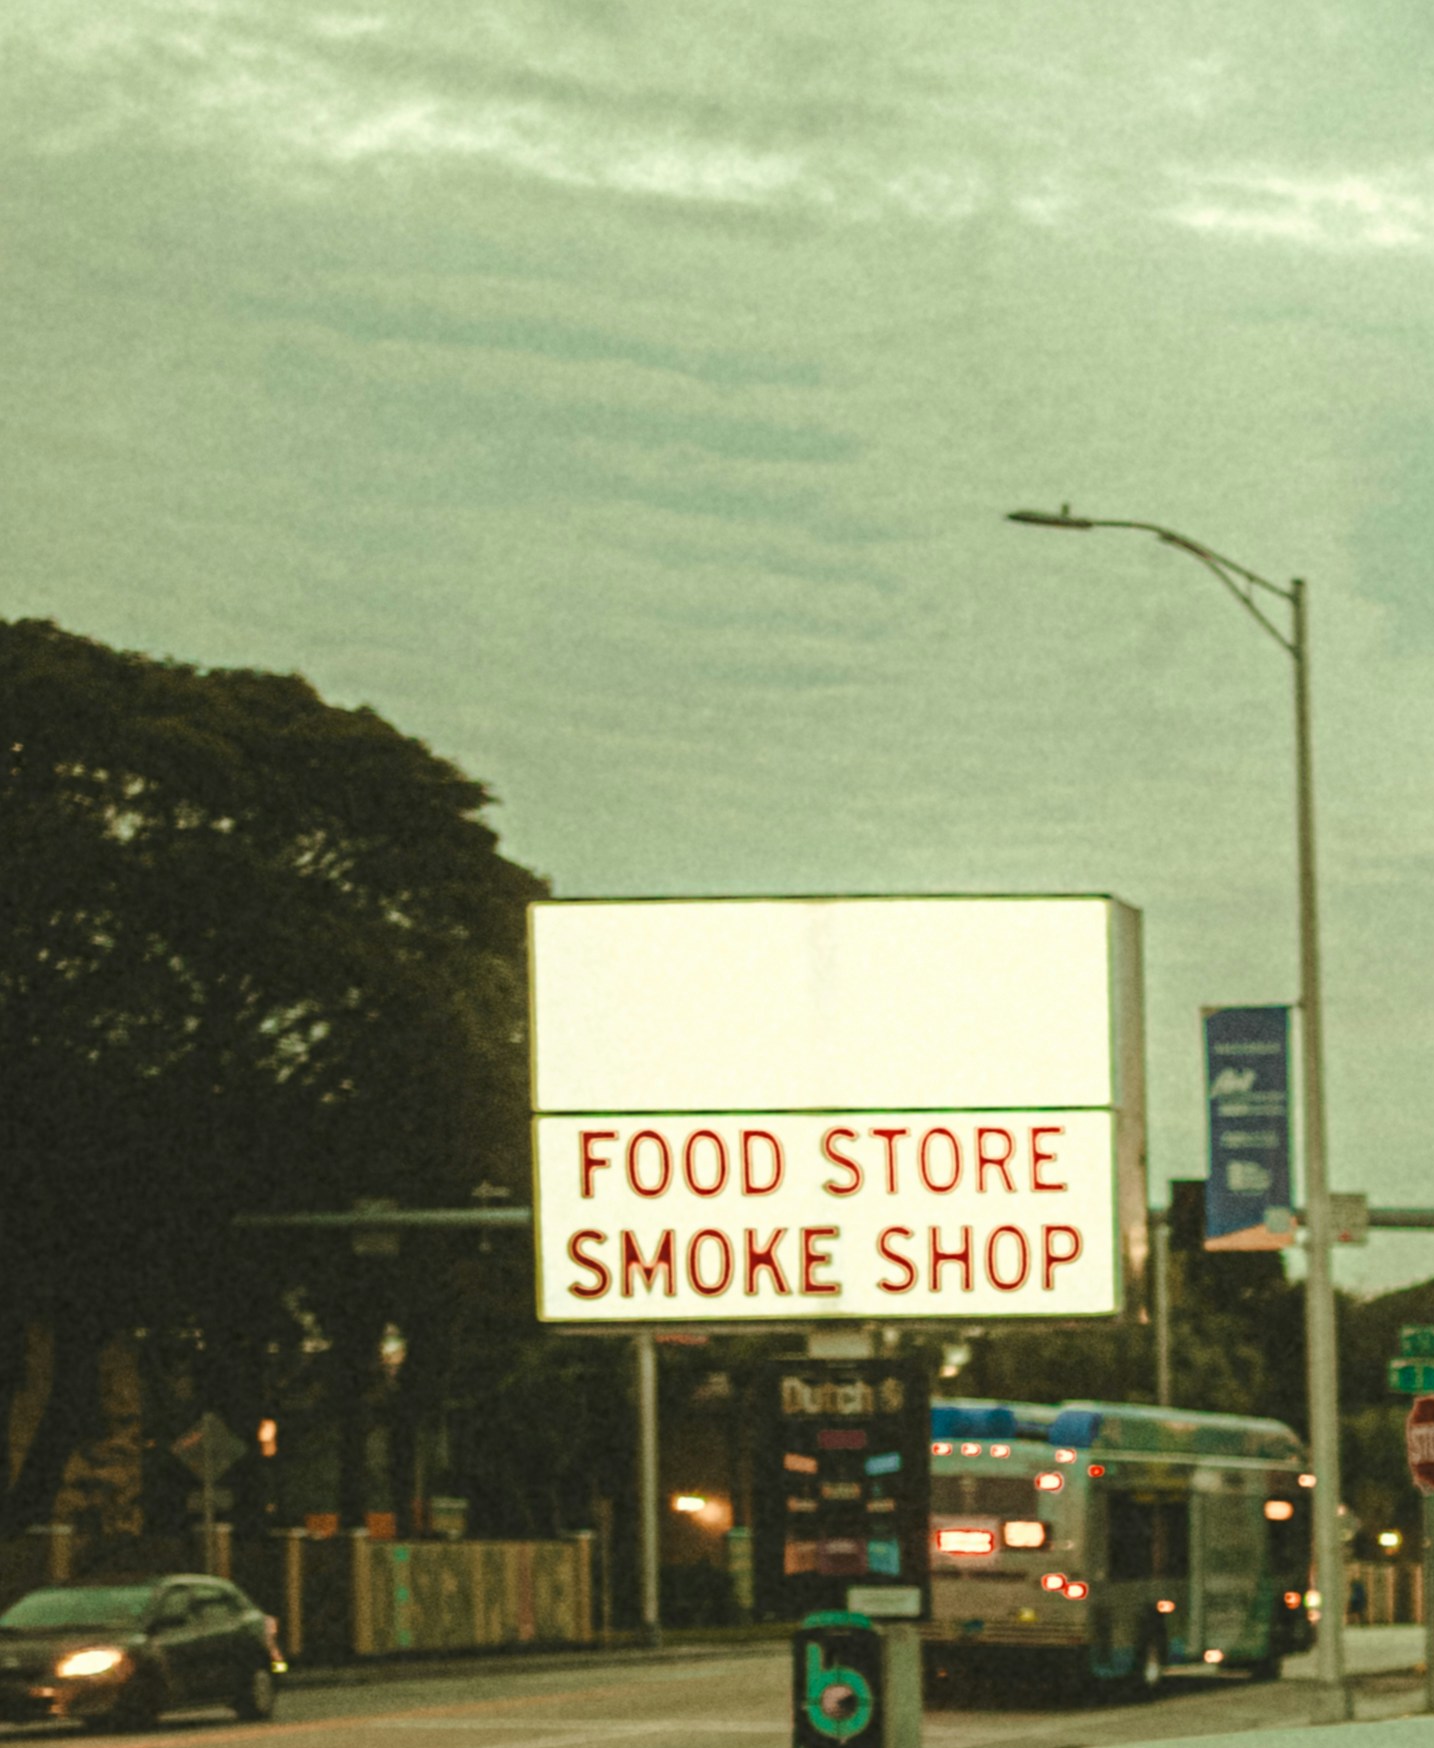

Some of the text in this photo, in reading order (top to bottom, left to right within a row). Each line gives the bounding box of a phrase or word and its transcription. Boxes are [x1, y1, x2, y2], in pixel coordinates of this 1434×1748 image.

[579, 1126, 1069, 1199] FOOD STORE
[567, 1223, 1083, 1300] SMOKE SHOP
